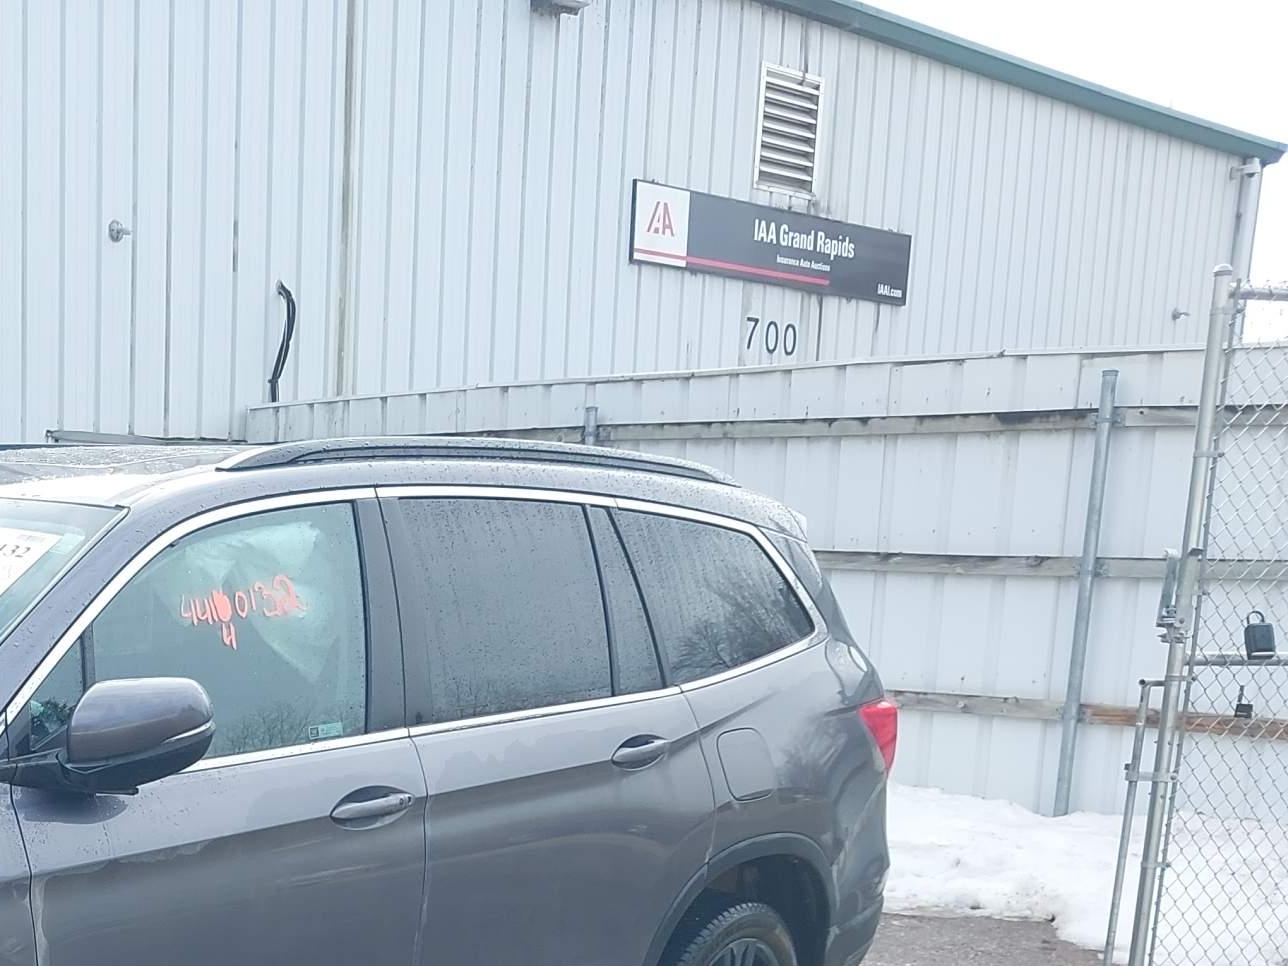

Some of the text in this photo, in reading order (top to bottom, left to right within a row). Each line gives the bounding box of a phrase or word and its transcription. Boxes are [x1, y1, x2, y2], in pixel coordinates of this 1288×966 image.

[753, 218, 855, 260] IAA Grand Rapids
[800, 257, 811, 268] Auto
[746, 316, 797, 356] 700
